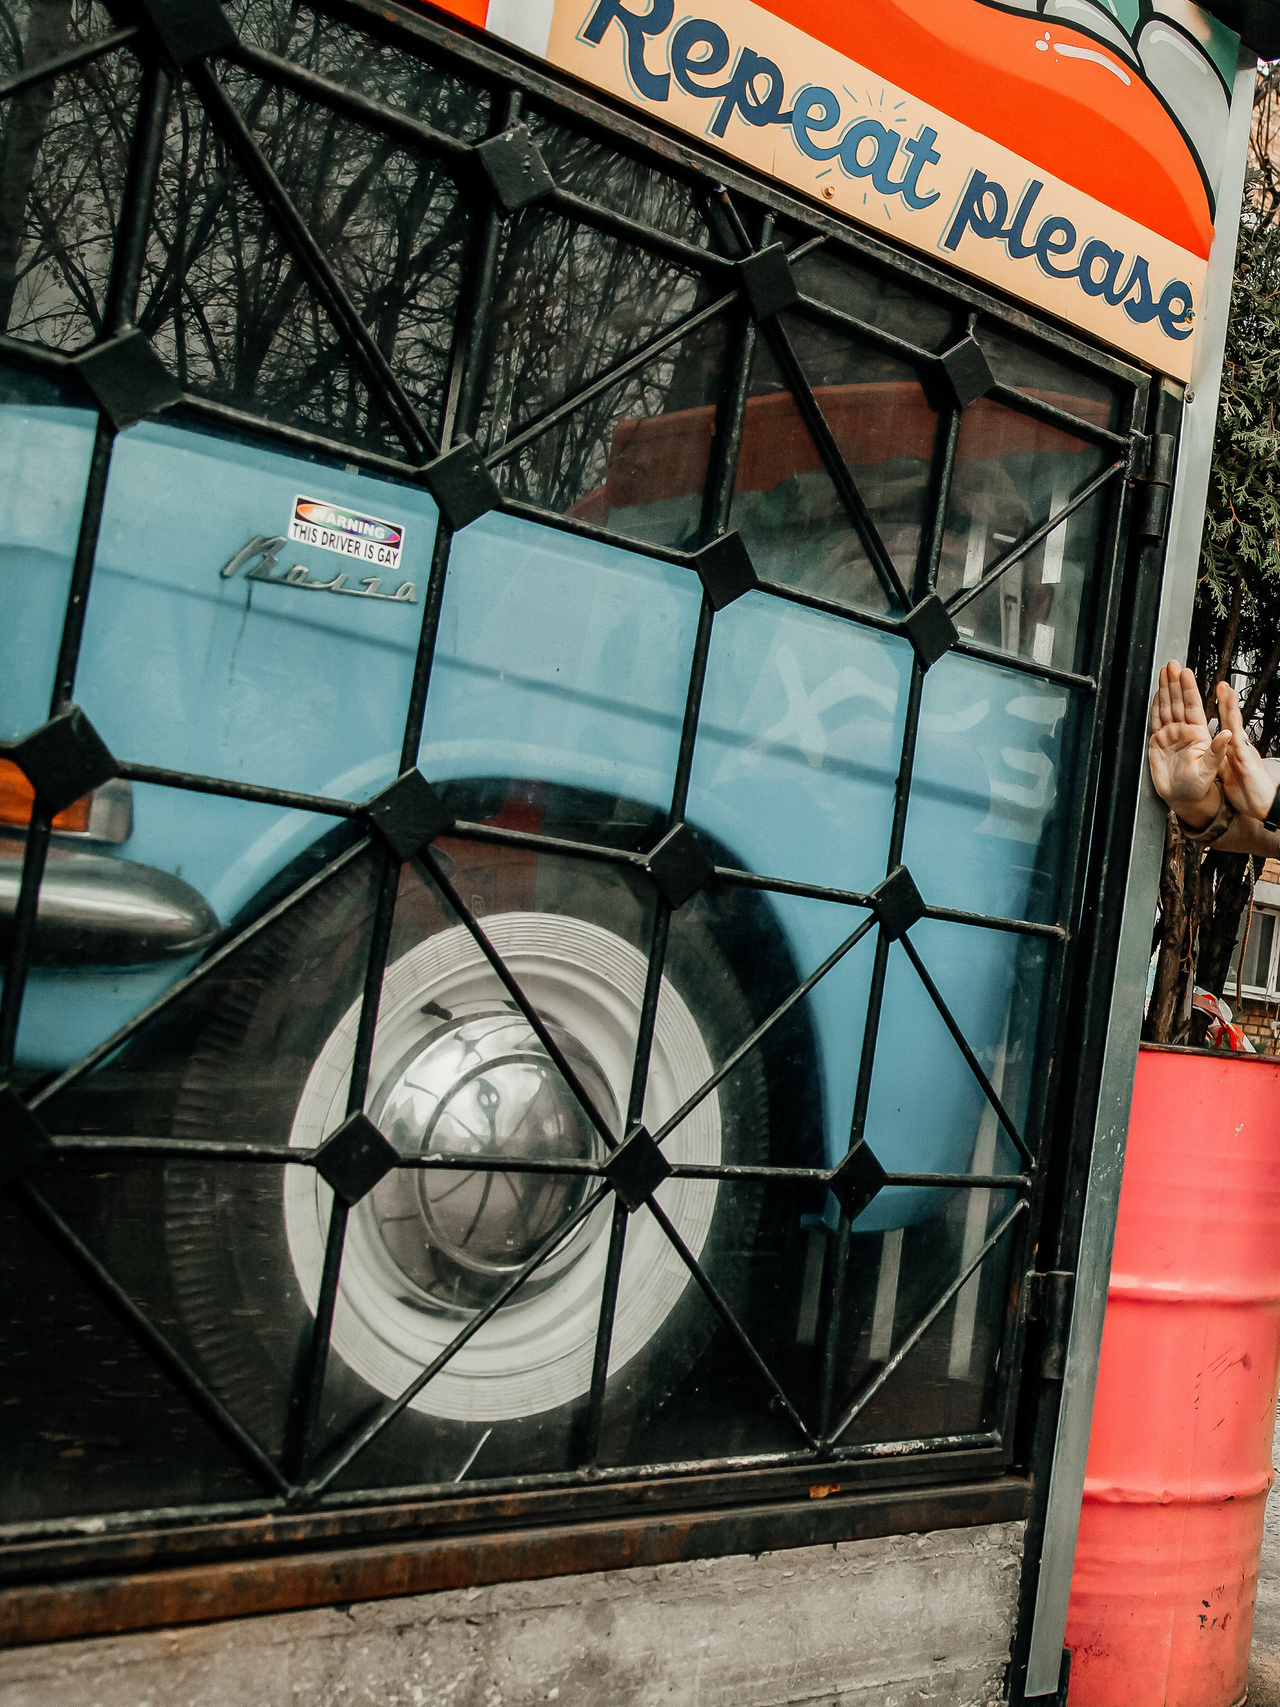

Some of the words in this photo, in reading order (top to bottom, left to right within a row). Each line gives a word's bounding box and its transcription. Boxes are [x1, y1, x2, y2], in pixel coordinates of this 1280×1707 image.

[580, 0, 941, 210] Repeat
[942, 168, 1195, 341] please
[292, 523, 318, 544] THIS
[321, 531, 361, 557] DRIVER
[363, 543, 375, 560] IS
[377, 548, 400, 567] GAY
[312, 507, 386, 540] WARNING
